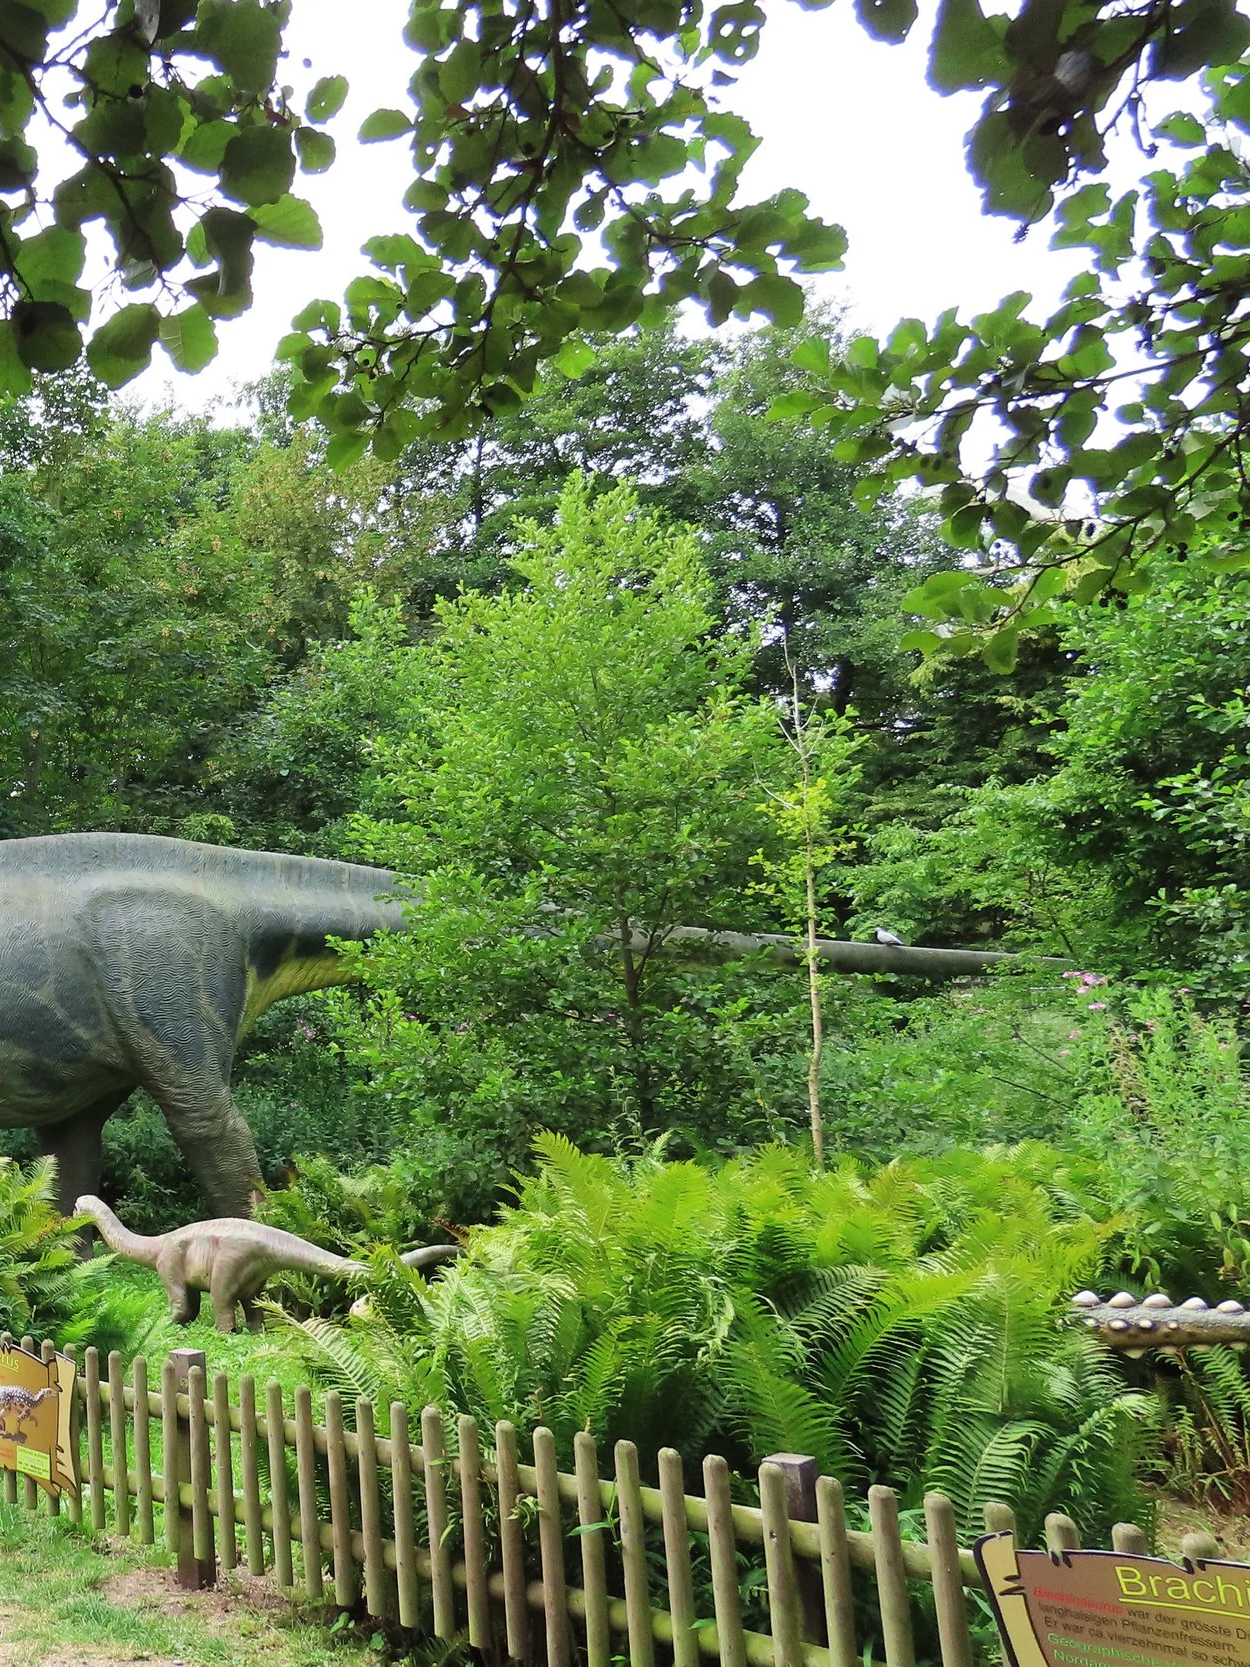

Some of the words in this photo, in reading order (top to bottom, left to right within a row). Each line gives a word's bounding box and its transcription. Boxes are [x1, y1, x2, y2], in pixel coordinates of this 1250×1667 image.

[1127, 1609, 1151, 1619] war
[1154, 1612, 1177, 1626] der
[1045, 1616, 1057, 1628] Er
[1191, 1650, 1209, 1661] so
